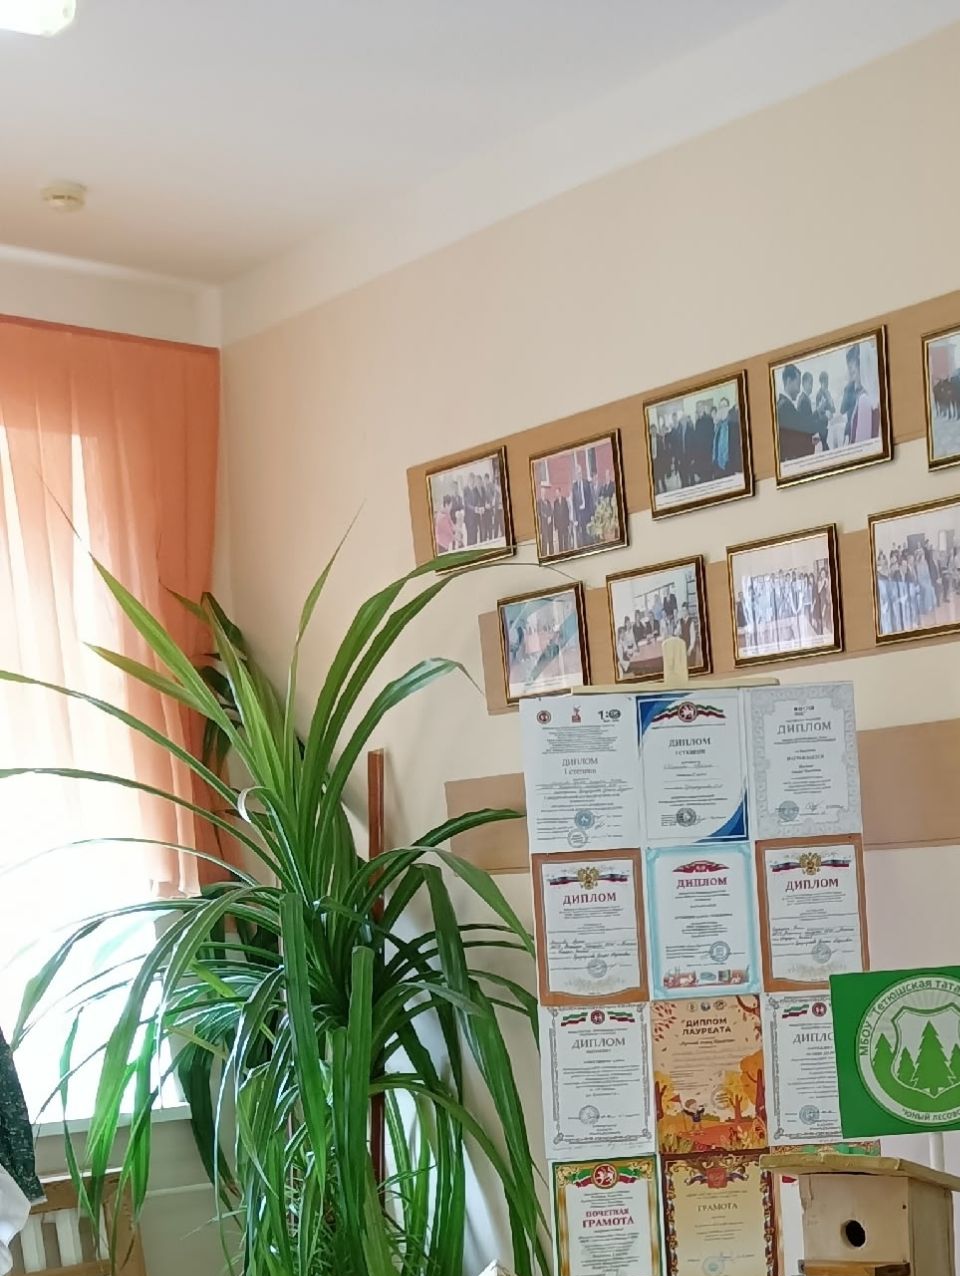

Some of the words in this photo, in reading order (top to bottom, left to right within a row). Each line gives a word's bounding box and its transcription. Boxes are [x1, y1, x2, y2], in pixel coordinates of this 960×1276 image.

[777, 721, 832, 735] ДИПЛОМ
[668, 737, 711, 748] ДИПЛОМ
[676, 877, 728, 889] ДИПЛОМ
[785, 878, 839, 892] ДИПЛОМ
[563, 892, 617, 906] ДИПЛОМ
[682, 1026, 732, 1036] ЛАУРЕАТА
[571, 1037, 626, 1049] ДИПЛОМ
[859, 1021, 873, 1057] МБОУ
[585, 1208, 630, 1218] ПОЧЕТНАЯ
[697, 1202, 738, 1212] ГРАМОТА
[582, 1216, 635, 1228] ГРАМОТА
